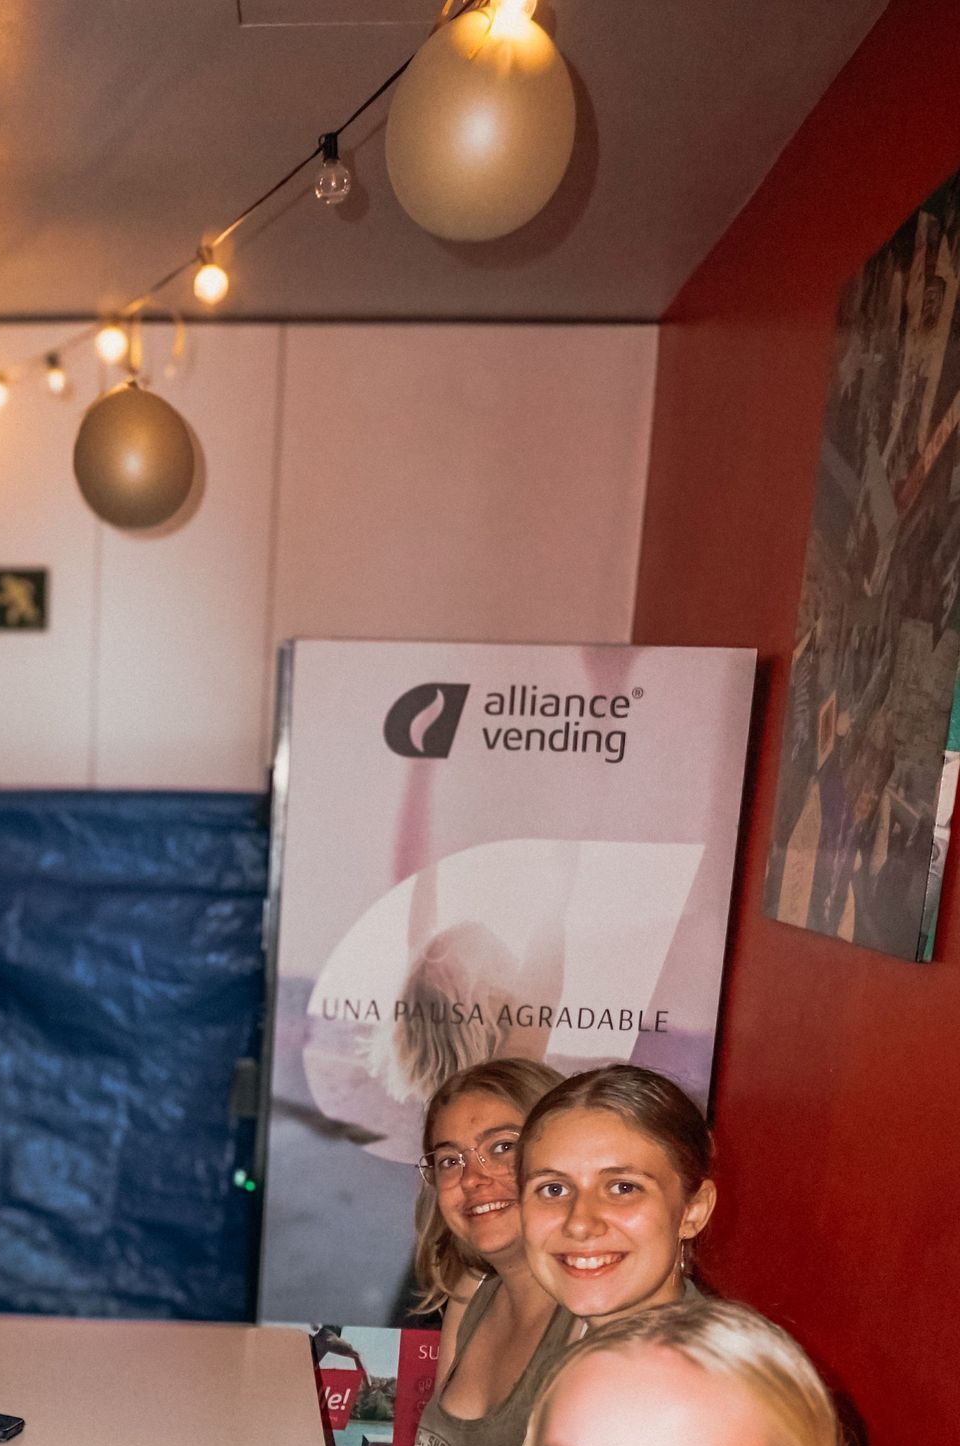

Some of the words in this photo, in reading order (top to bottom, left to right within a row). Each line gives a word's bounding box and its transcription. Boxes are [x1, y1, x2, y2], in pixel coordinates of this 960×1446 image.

[482, 720, 627, 764] vending
[322, 998, 380, 1021] UNA
[394, 1000, 484, 1026] PAUSA
[496, 1004, 669, 1033] AGRADABLE
